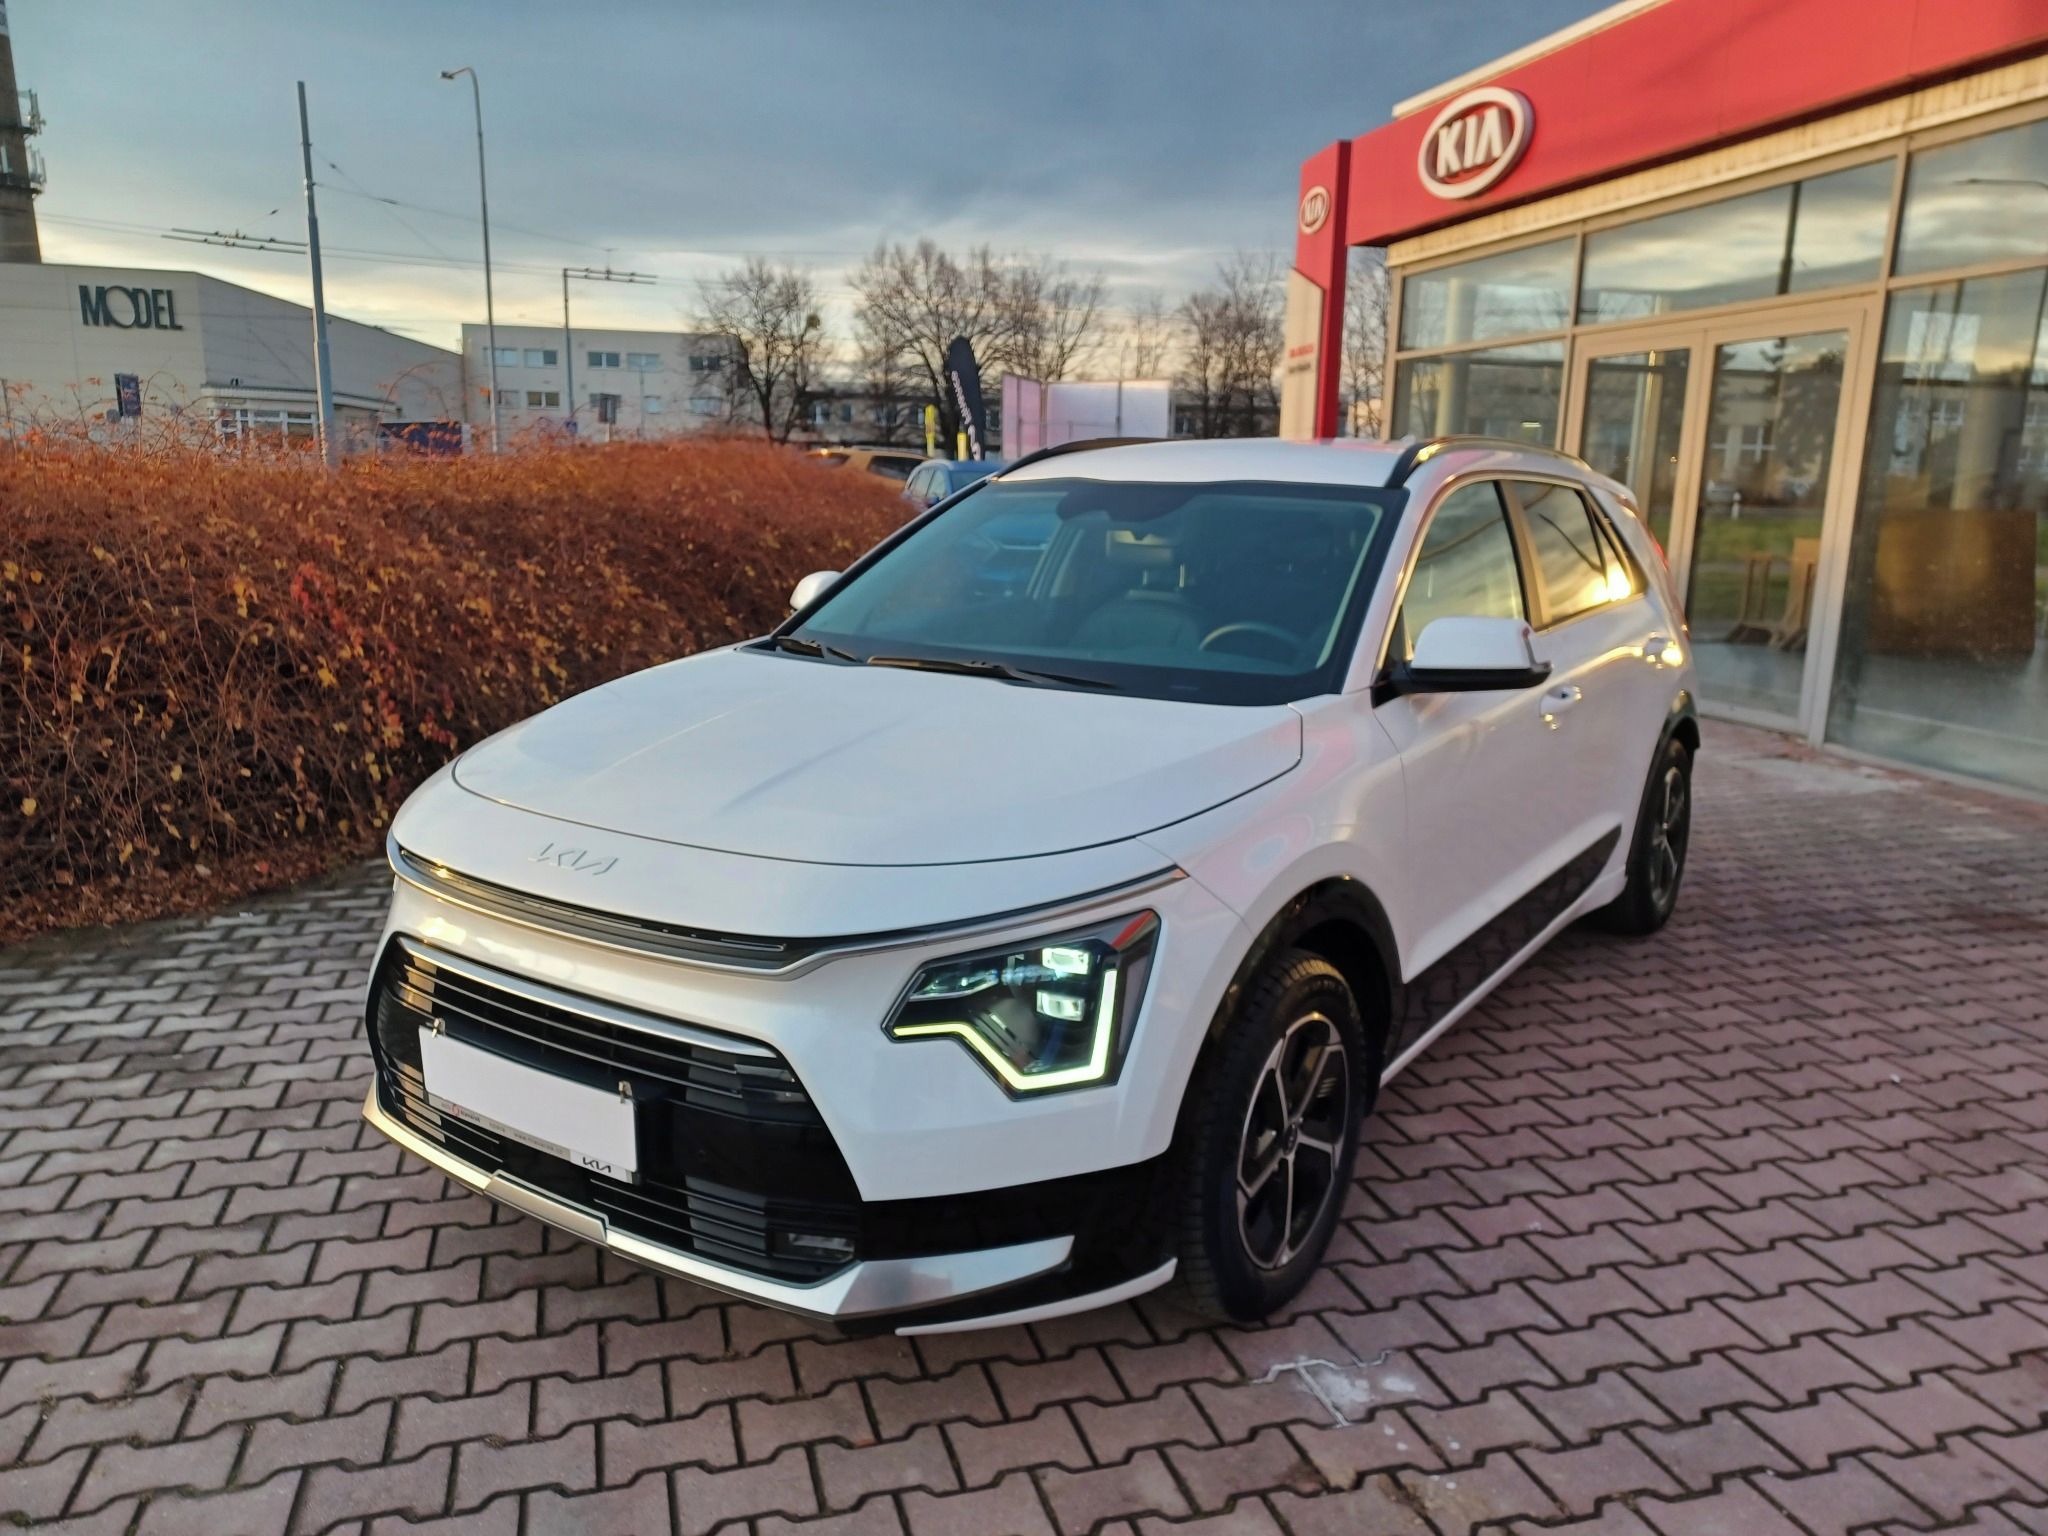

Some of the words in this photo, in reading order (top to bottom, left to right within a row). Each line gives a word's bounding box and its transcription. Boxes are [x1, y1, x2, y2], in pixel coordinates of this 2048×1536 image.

[1436, 106, 1503, 178] KIA
[78, 285, 184, 331] MODEL
[533, 842, 619, 876] KIA
[582, 1156, 612, 1174] KIA
